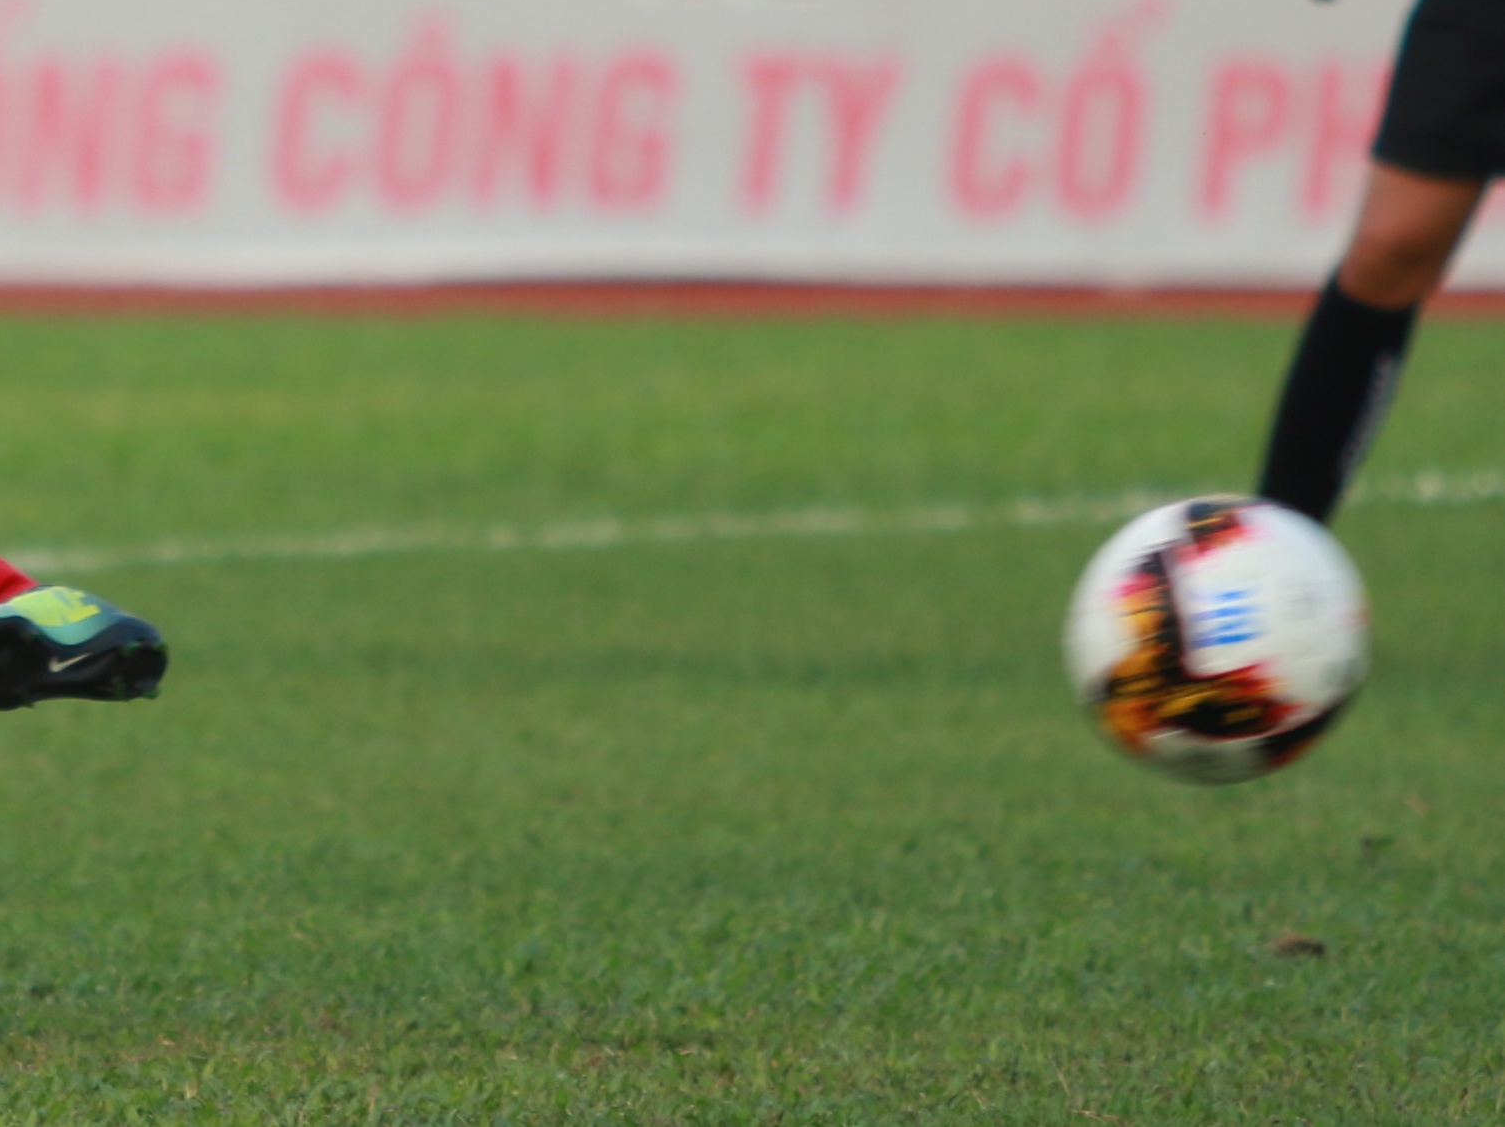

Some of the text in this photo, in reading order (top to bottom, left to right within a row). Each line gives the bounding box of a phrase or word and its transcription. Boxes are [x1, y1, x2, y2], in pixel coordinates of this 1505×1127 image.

[267, 8, 679, 216] CÔNG
[733, 48, 906, 216] TY
[1193, 52, 1391, 220] PH
